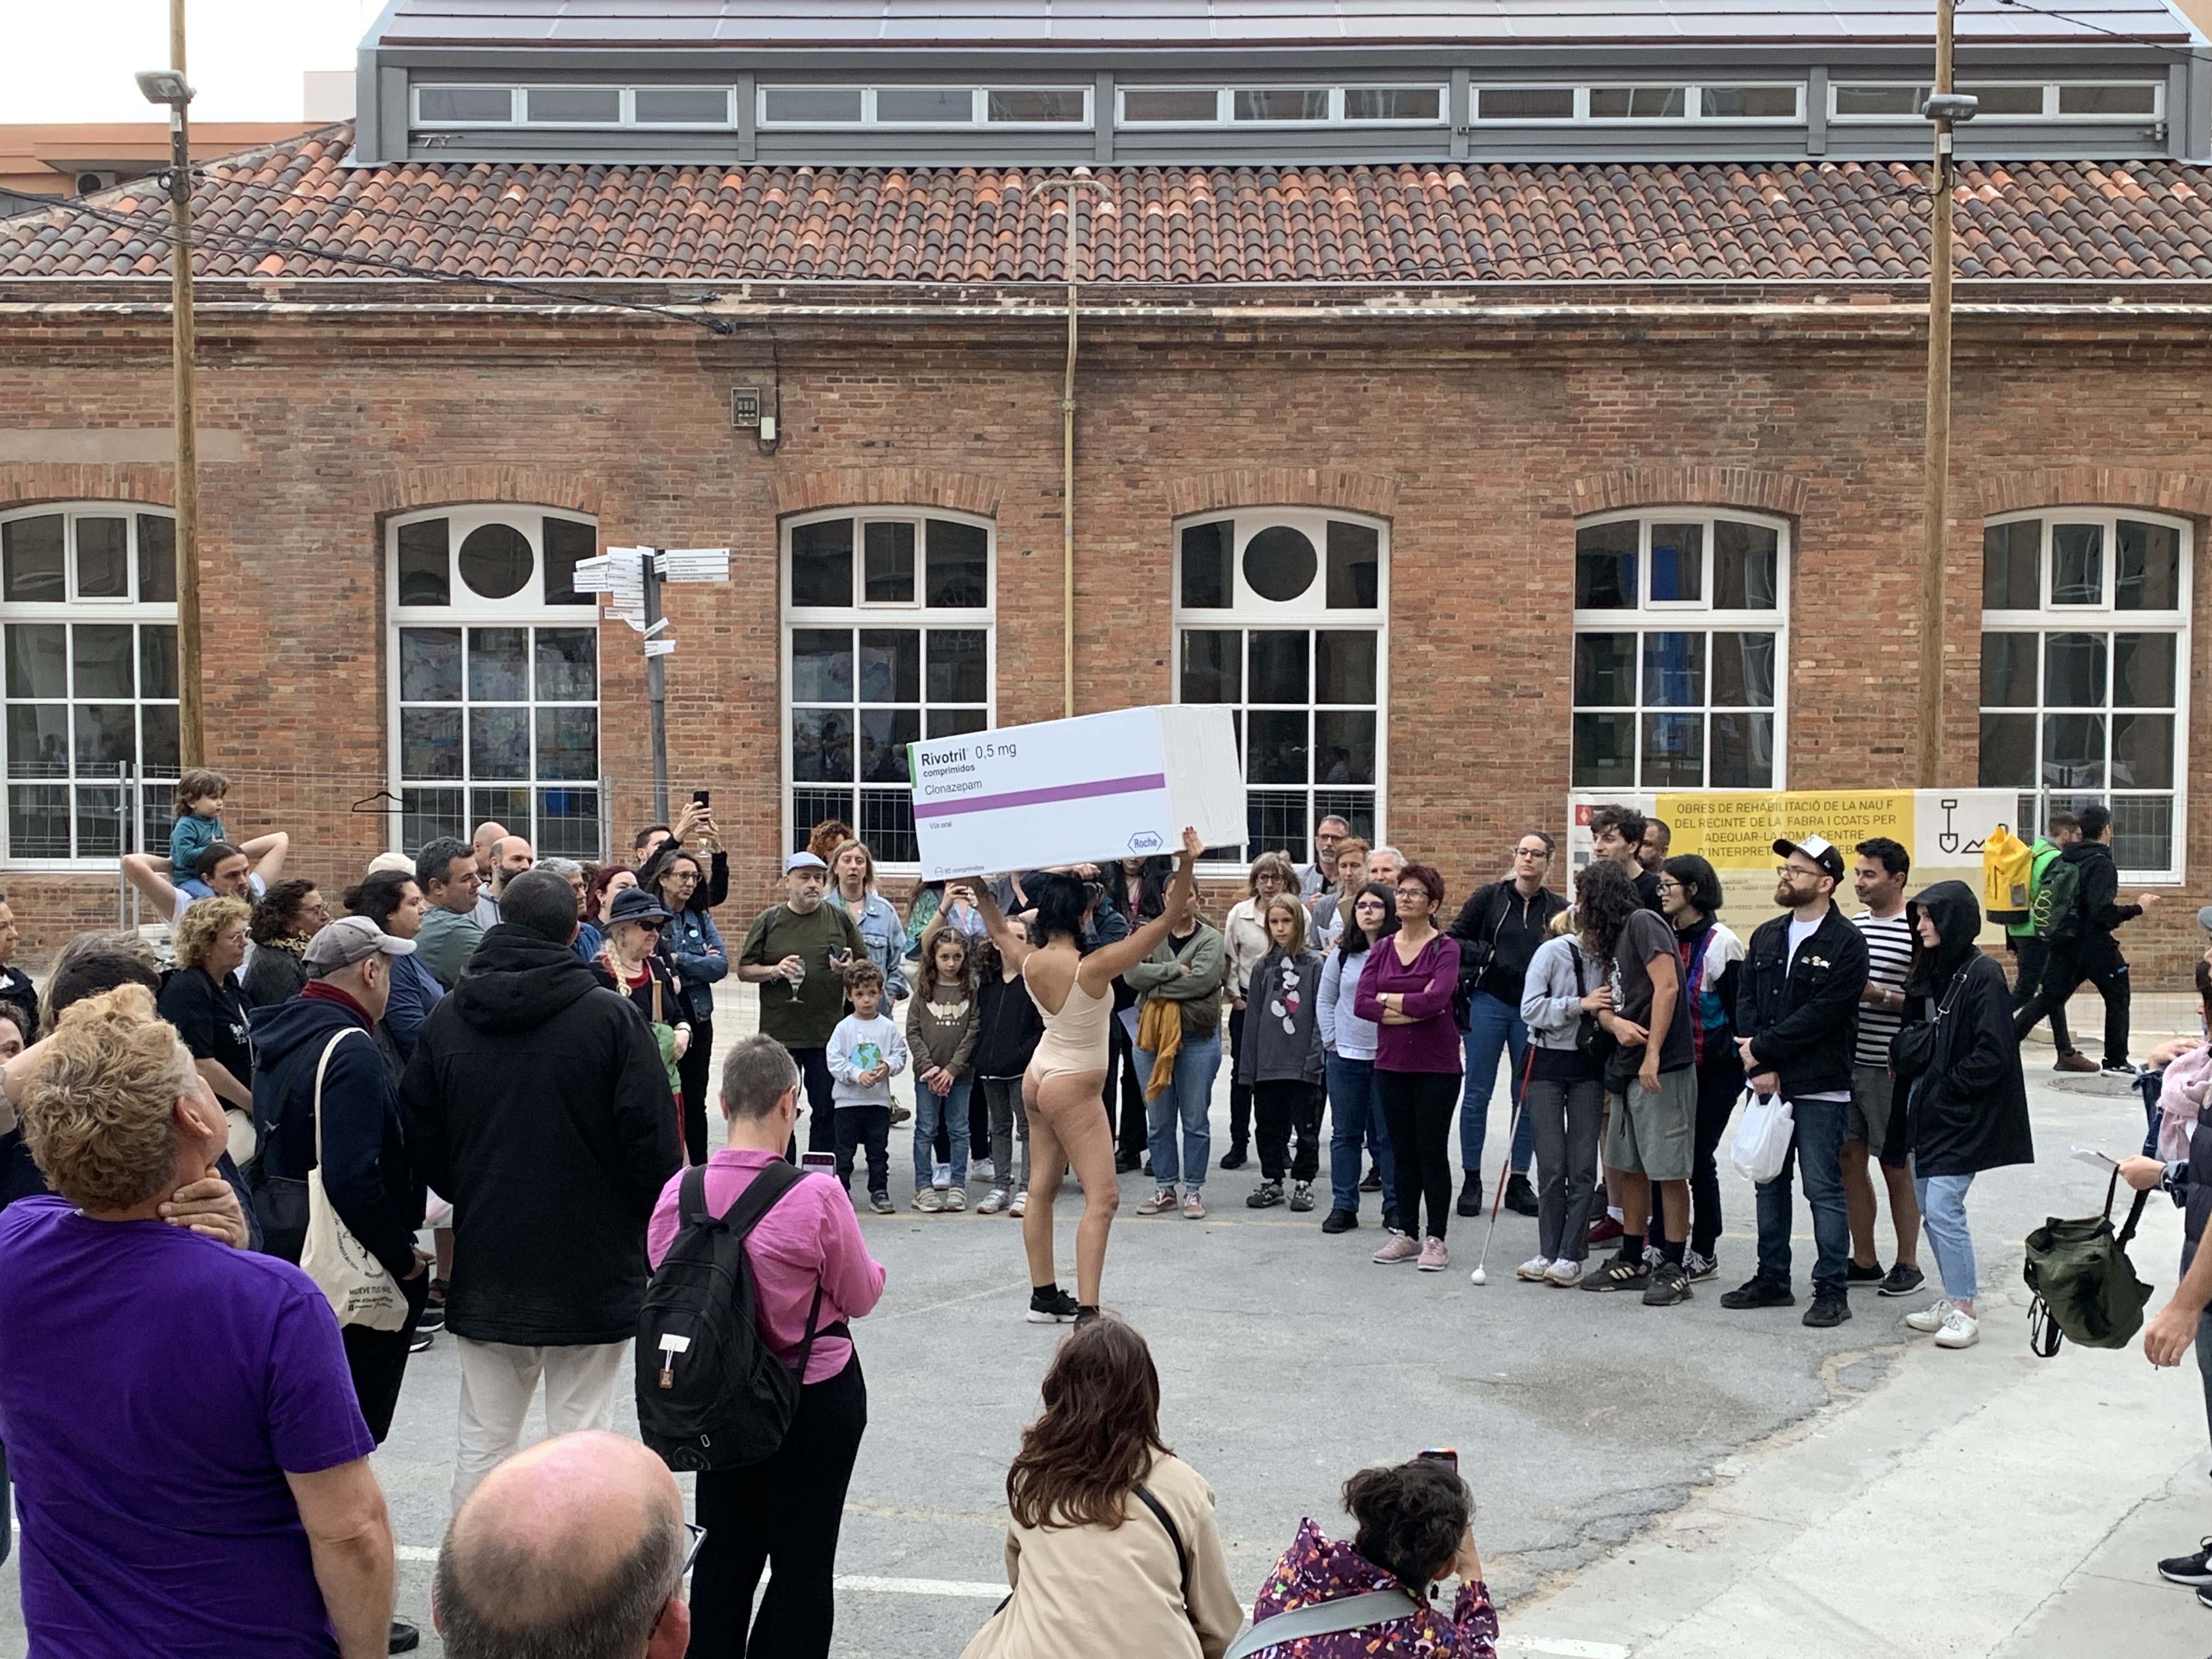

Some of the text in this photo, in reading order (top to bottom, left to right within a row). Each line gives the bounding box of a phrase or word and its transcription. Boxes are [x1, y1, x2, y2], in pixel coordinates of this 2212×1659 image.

[975, 744, 994, 760] 0,5
[998, 743, 1017, 758] mg
[923, 764, 975, 777] comprimidos
[924, 780, 983, 795] Clonazepam
[1677, 800, 1894, 814] OBRES DE REHABILITACIÓ DE LA NAU F
[1675, 815, 1897, 828] DEL RECINTE DE LA FABRA I COATS PER
[1134, 837, 1158, 848] Roche
[1705, 831, 1777, 842] ADEQUAR-LA
[1780, 831, 1805, 841] COM
[1819, 830, 1865, 840] CENTRE
